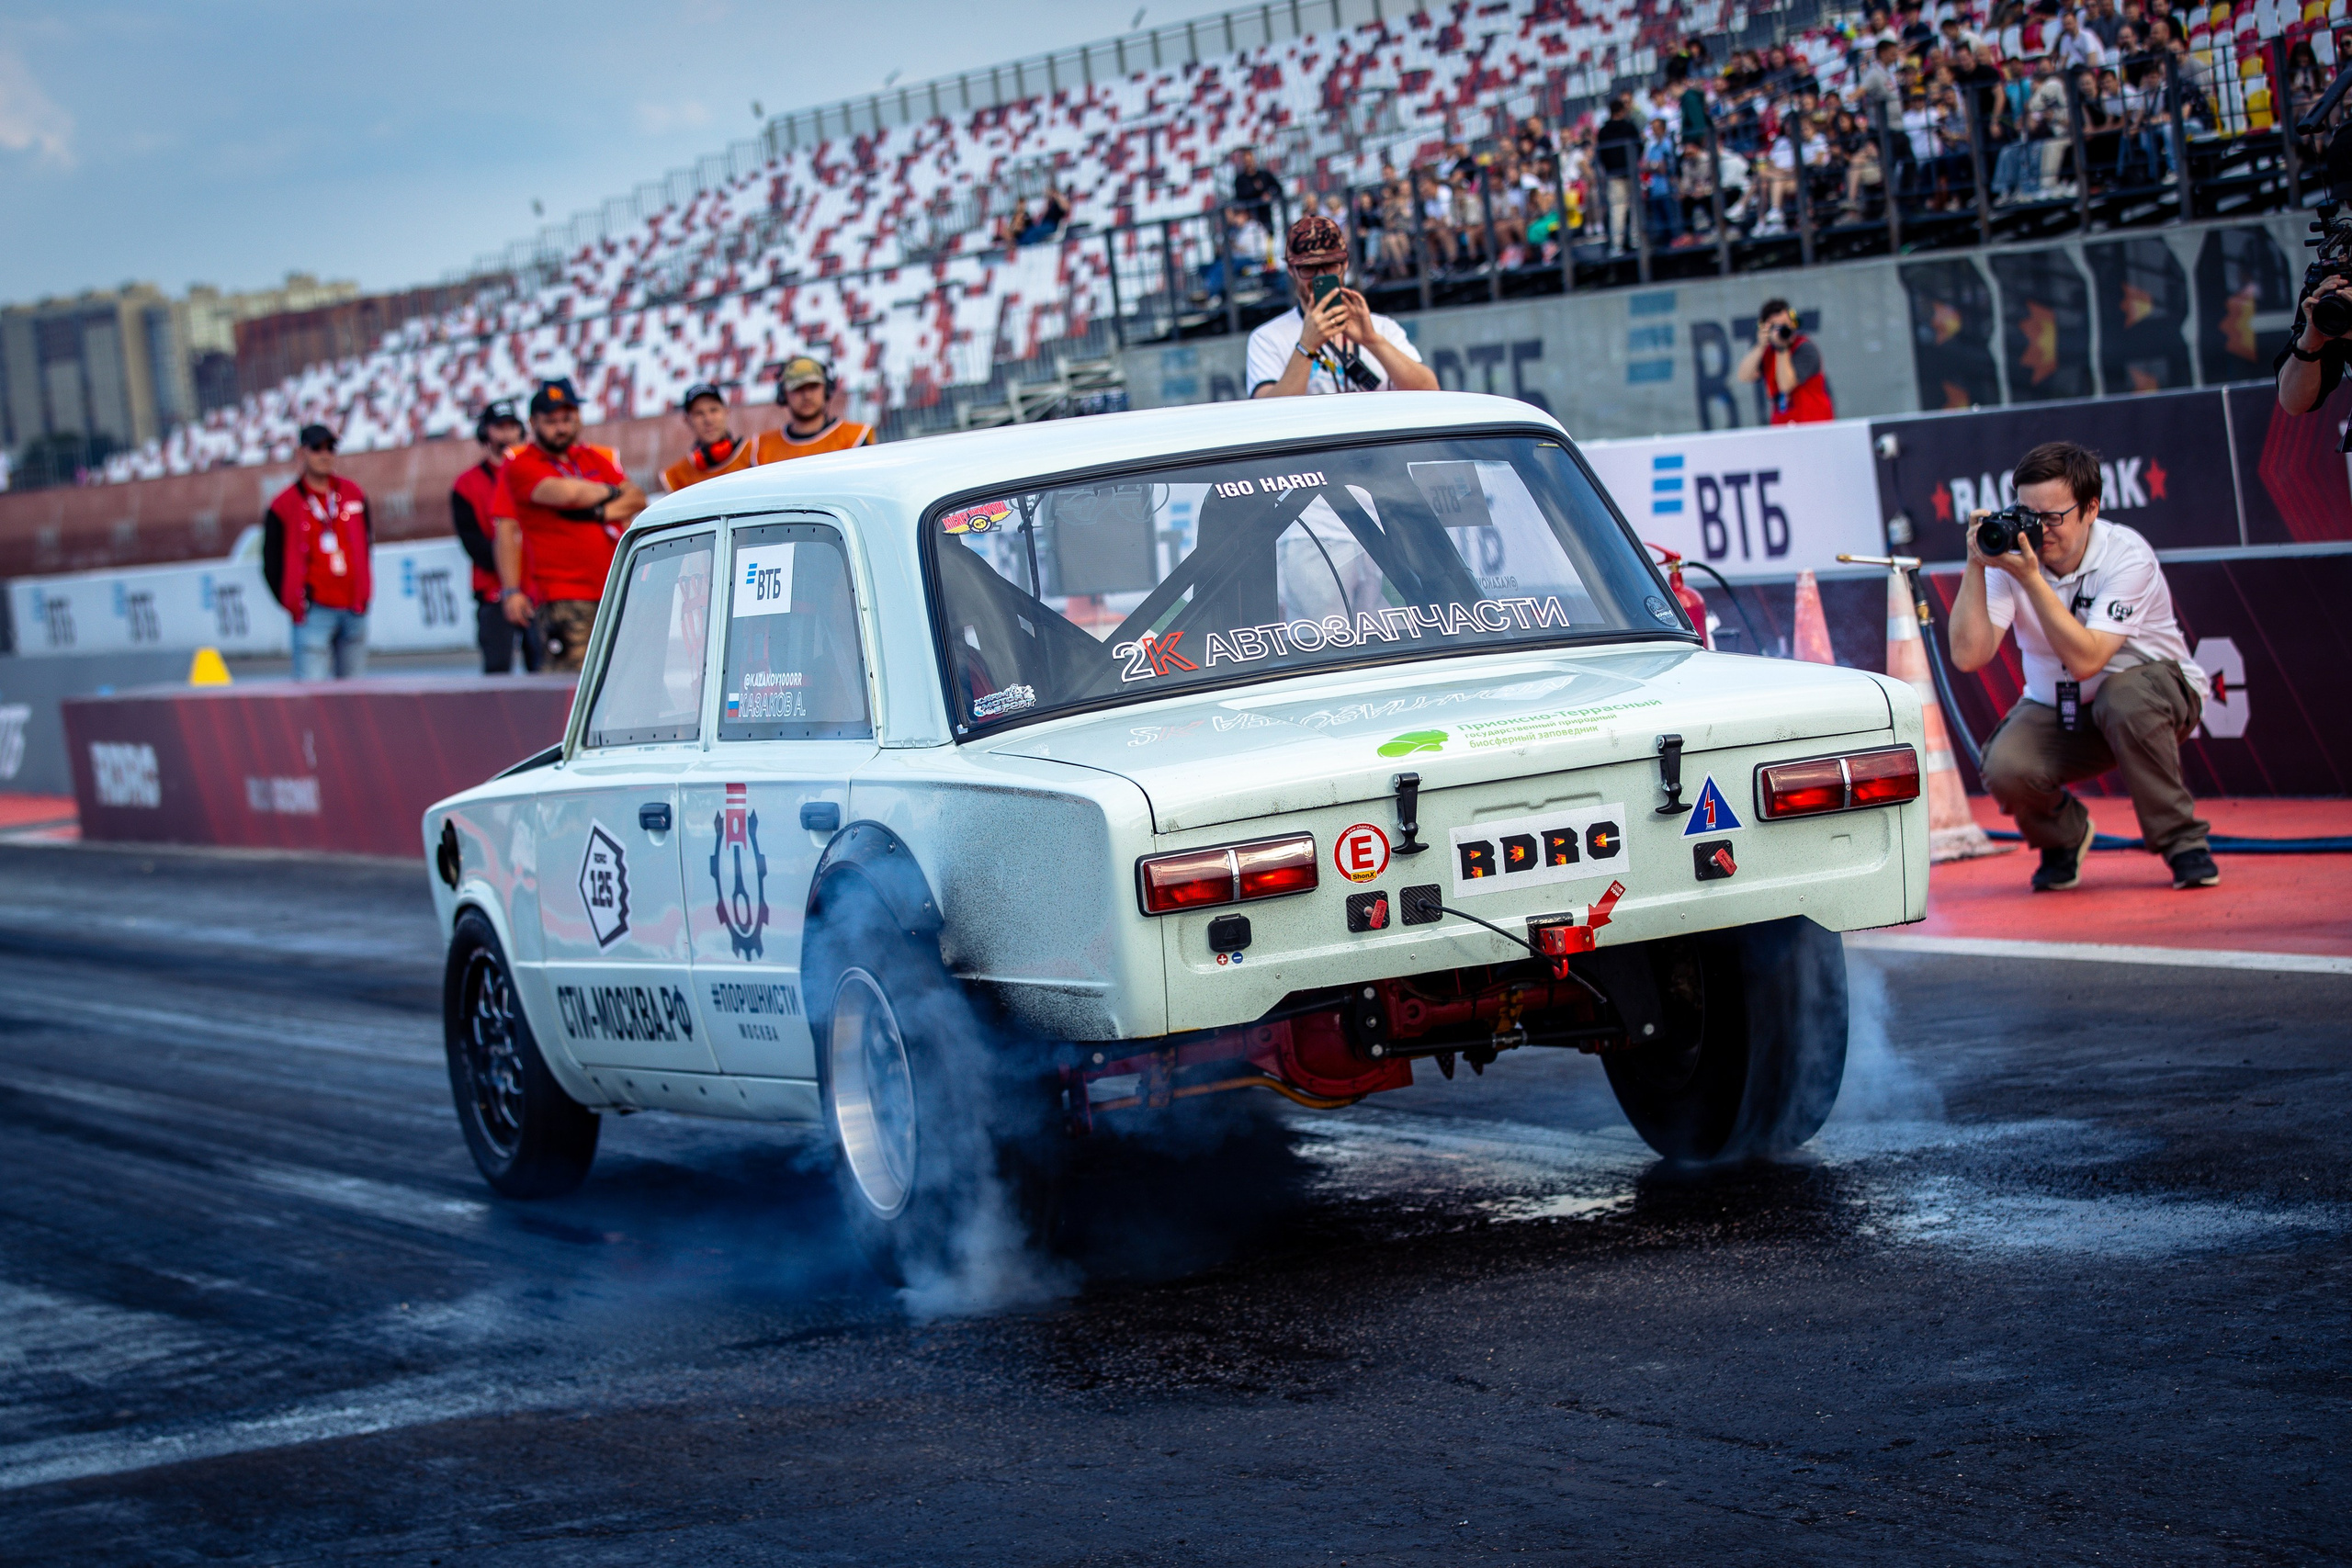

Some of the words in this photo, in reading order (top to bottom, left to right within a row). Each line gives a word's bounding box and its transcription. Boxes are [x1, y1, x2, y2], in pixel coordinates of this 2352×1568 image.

[1215, 479, 1254, 499] !GO
[1259, 471, 1329, 492] HARD!
[942, 512, 968, 531] MICKEY
[967, 501, 1008, 517] THOMPSON
[1695, 468, 1791, 560] ВТБ
[757, 568, 781, 601] ВТБ
[1205, 596, 1570, 668] АВТОЗАПЧАСТИ
[738, 692, 793, 717] КАЗАКОВ
[793, 691, 807, 716] А.
[1456, 699, 1663, 732] Приокско-Террасный
[1464, 720, 1556, 739] государственный
[1558, 714, 1617, 728] природный
[1469, 732, 1536, 749] биосферный
[1538, 724, 1599, 739] заповедник
[1350, 835, 1374, 870] E
[1457, 820, 1622, 880] RDRC
[590, 869, 614, 909] 125
[1352, 871, 1375, 880] ShonX
[558, 985, 694, 1042] СТИ-МОСКВА.РФ
[711, 983, 802, 1016] #ПОРШНИСТИ
[738, 1022, 780, 1042] МОСКВА
